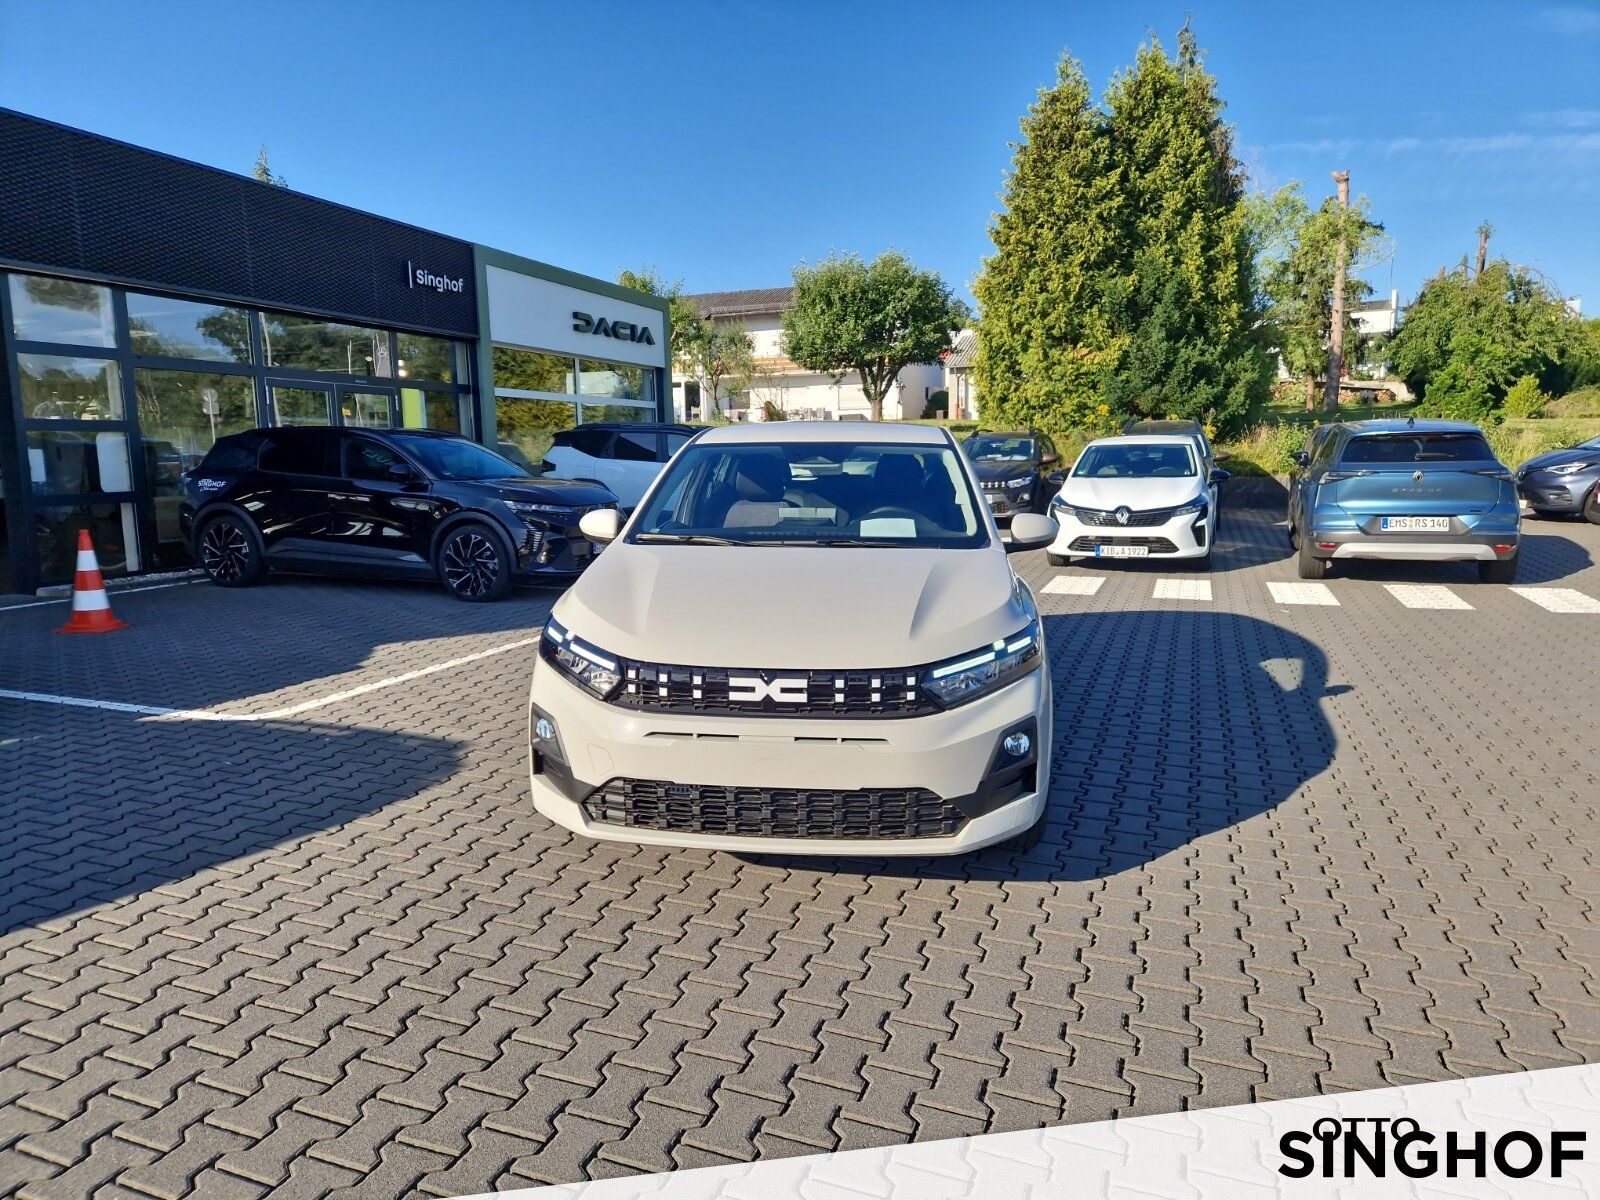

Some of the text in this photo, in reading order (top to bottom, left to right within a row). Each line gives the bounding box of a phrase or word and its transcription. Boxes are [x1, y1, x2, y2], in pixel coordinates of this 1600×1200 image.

[416, 269, 464, 293] Singhof
[572, 311, 656, 346] DACIA
[1414, 518, 1428, 528] RS
[1430, 518, 1449, 528] 140
[1127, 547, 1147, 556] 1922
